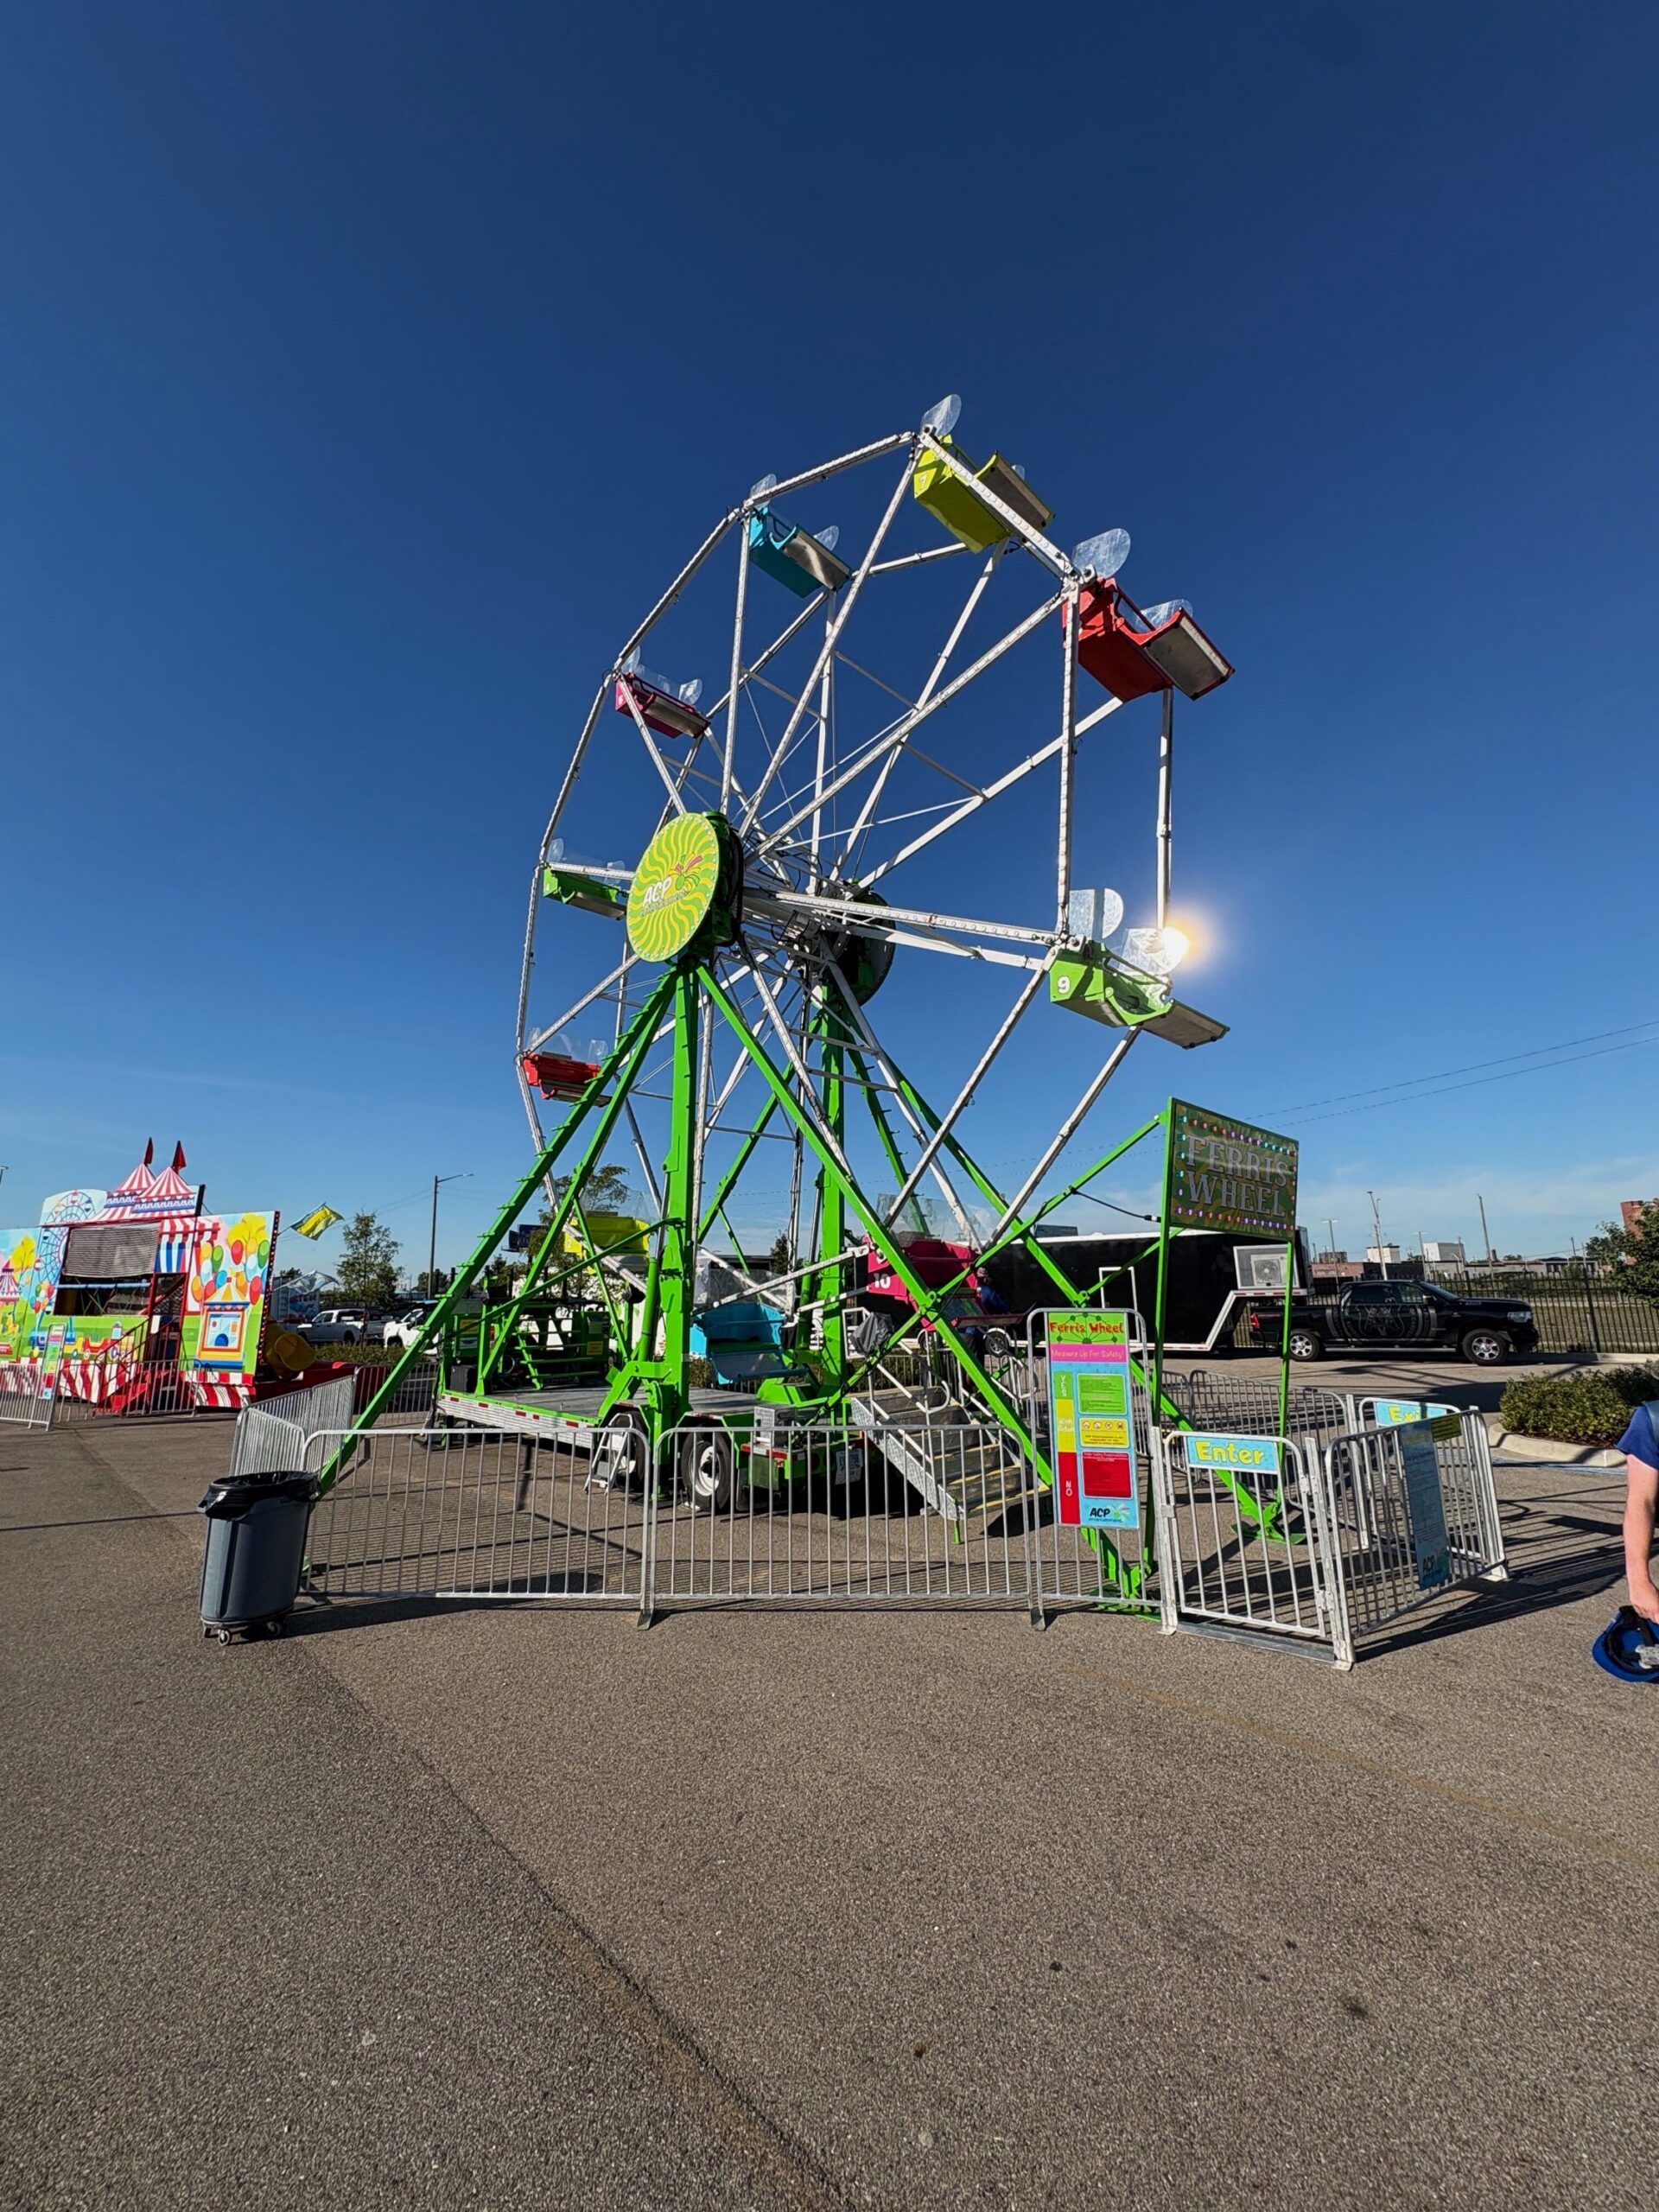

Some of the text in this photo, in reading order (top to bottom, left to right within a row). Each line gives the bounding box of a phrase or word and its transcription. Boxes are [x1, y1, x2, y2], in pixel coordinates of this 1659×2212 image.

[642, 876, 672, 908] ACP
[1057, 976, 1071, 994] 9
[1186, 1135, 1289, 1187] FERRIS
[1186, 1171, 1286, 1217] WHEEL
[874, 1272, 891, 1289] 10
[1049, 1321, 1124, 1334] Ferris Wheel
[1079, 1350, 1088, 1359] Up
[1195, 1440, 1265, 1465] Enter
[1065, 1480, 1072, 1497] NO
[1090, 1508, 1110, 1517] ACP
